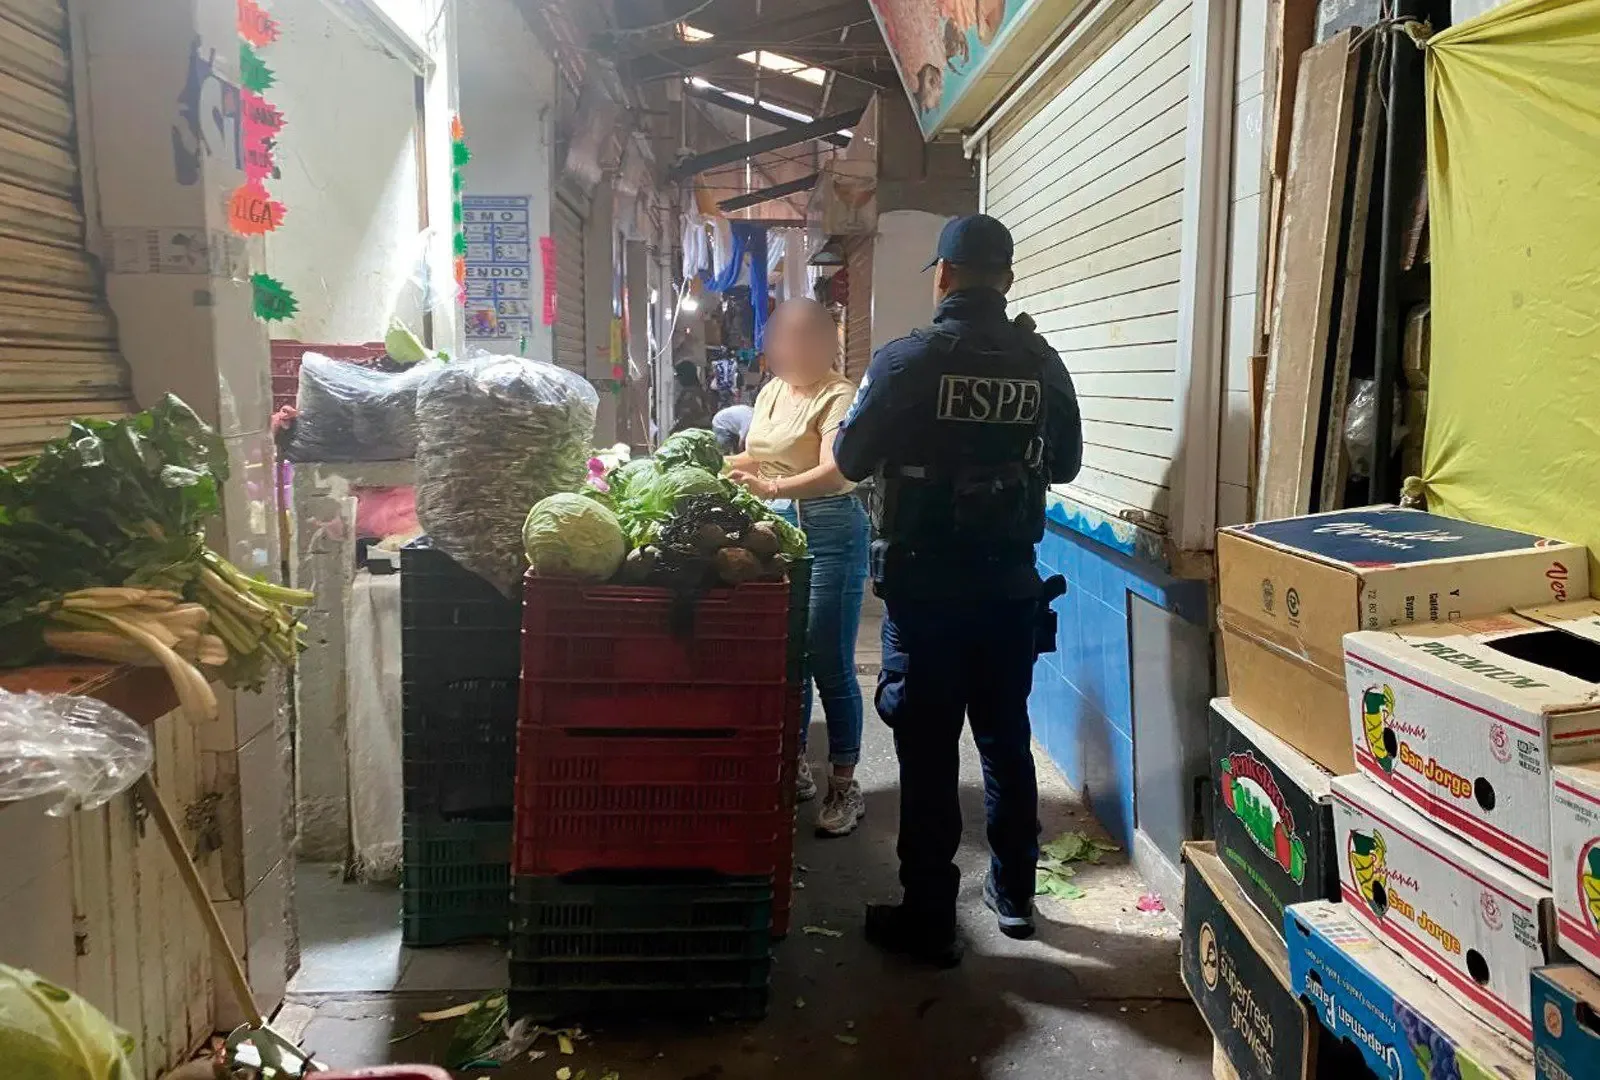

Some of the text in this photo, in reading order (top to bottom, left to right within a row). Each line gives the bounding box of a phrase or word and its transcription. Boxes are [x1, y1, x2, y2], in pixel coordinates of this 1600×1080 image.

[944, 379, 1038, 421] FSPE
[1410, 641, 1549, 689] PREMIUM
[1400, 742, 1473, 799] San Jorge
[1388, 888, 1461, 955] San Jorge
[1220, 957, 1274, 1048] superfresh
[1231, 1001, 1273, 1075] growers
